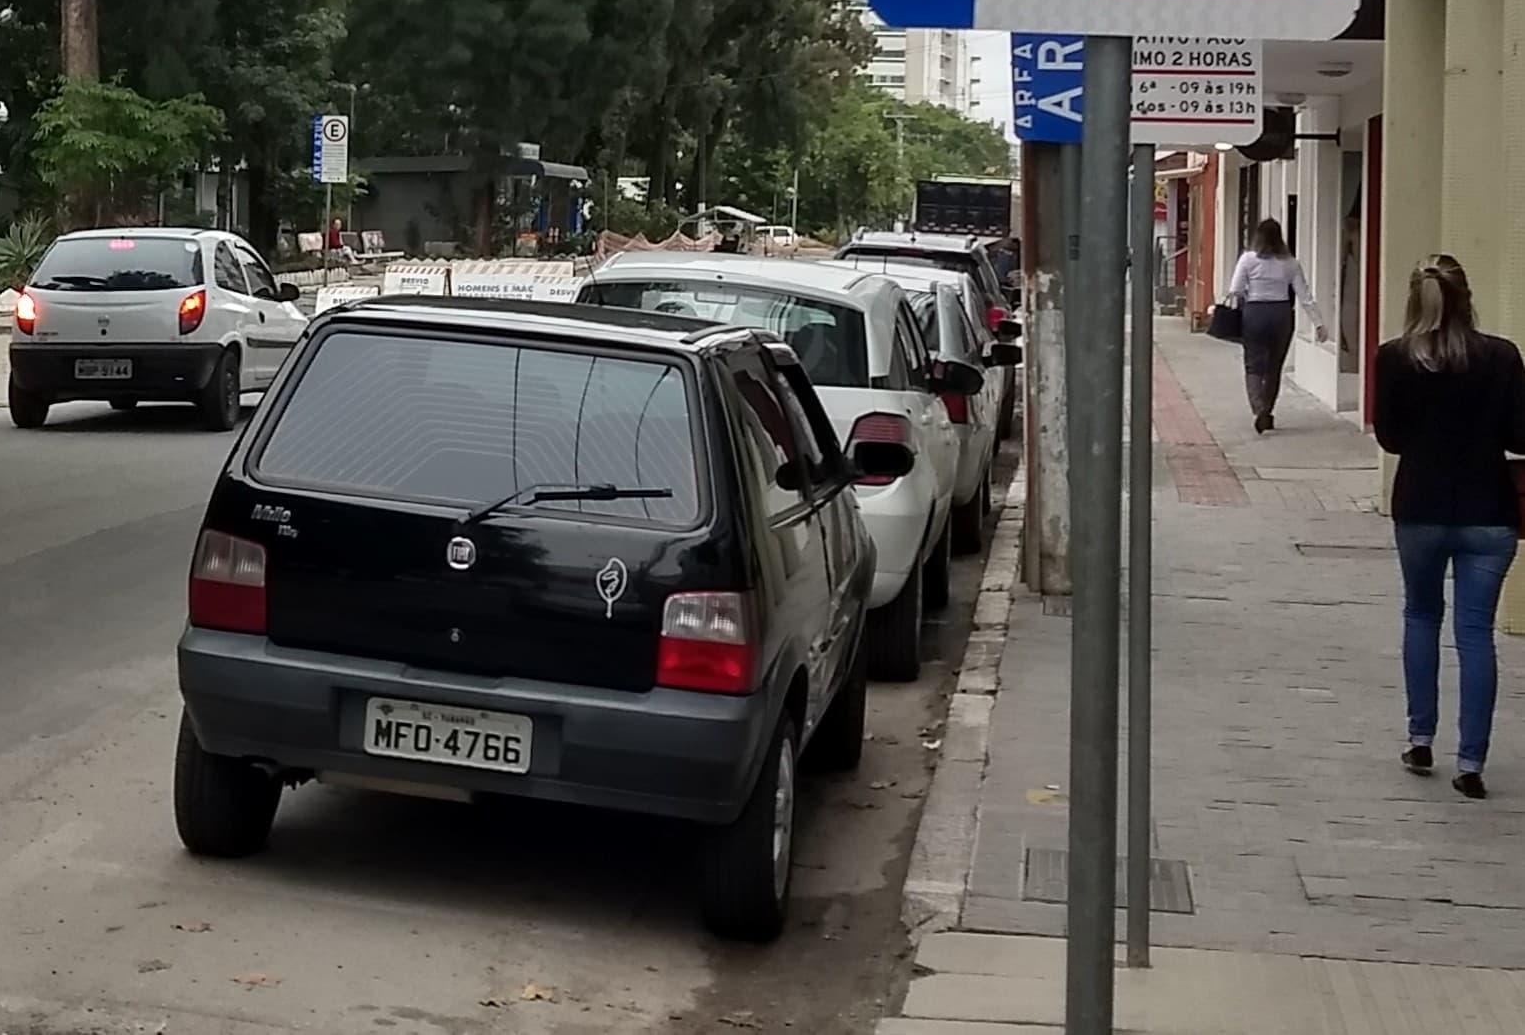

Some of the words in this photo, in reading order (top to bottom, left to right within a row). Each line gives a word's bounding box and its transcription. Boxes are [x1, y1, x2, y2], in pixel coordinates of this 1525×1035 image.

[1171, 51, 1183, 67] 2
[1189, 51, 1253, 67] HORAS
[1179, 81, 1200, 94] 09
[1229, 82, 1256, 95] 19h
[1179, 100, 1200, 113] 09
[1229, 101, 1256, 114] 13h
[331, 123, 340, 138] E
[458, 284, 500, 292] HOMENS
